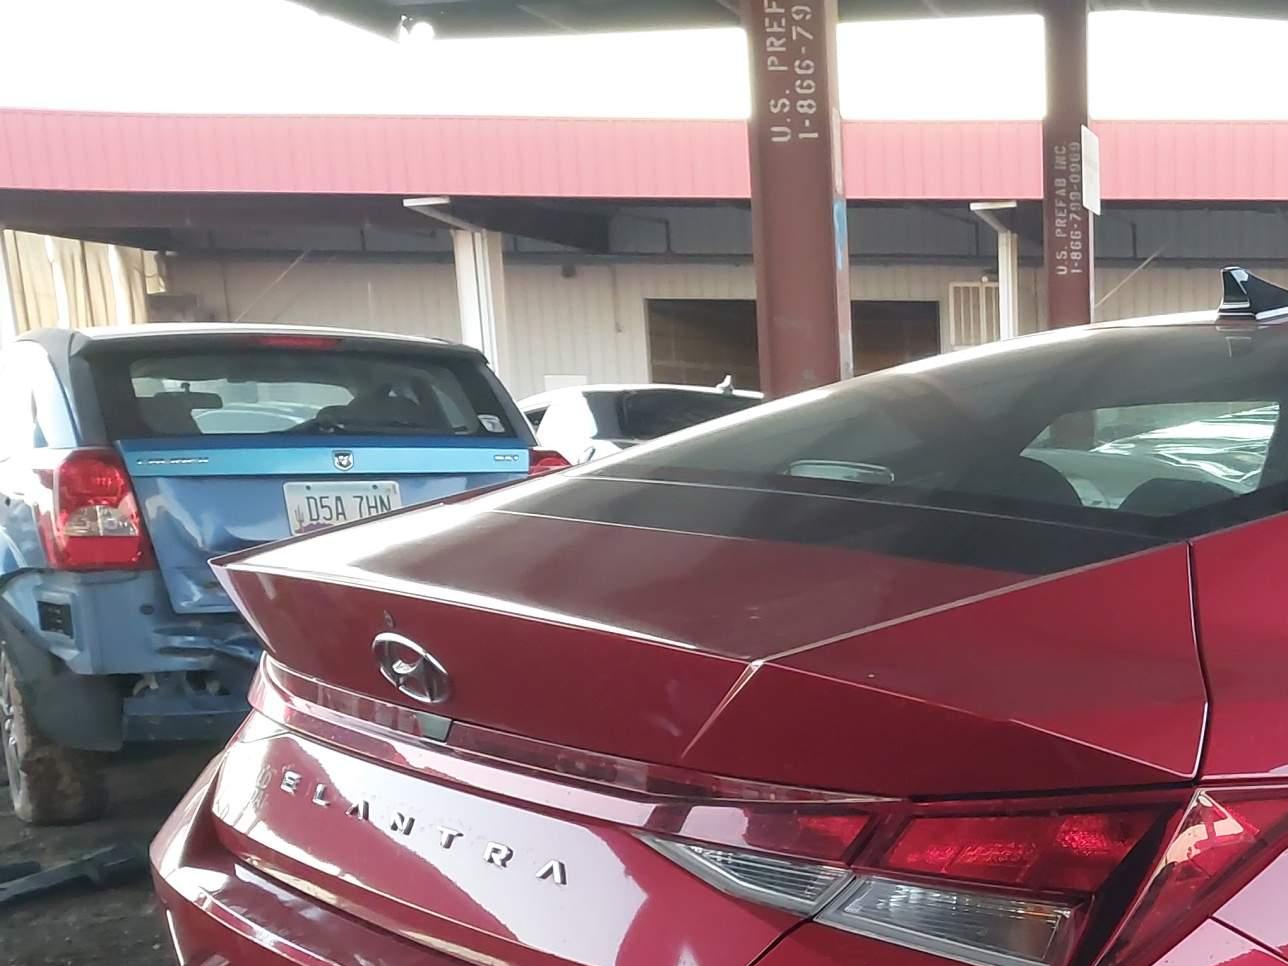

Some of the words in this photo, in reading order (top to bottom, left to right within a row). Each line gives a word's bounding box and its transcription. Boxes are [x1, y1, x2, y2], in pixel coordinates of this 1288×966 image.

[765, 0, 789, 71] PREF
[791, 4, 819, 140] 1-866-79
[769, 89, 791, 143] U.S.
[1054, 178, 1067, 237] PREFAB
[1055, 246, 1068, 275] U.S.
[306, 496, 347, 521] D5A
[352, 495, 391, 518] 7HN
[280, 769, 568, 886] ELANTRA
